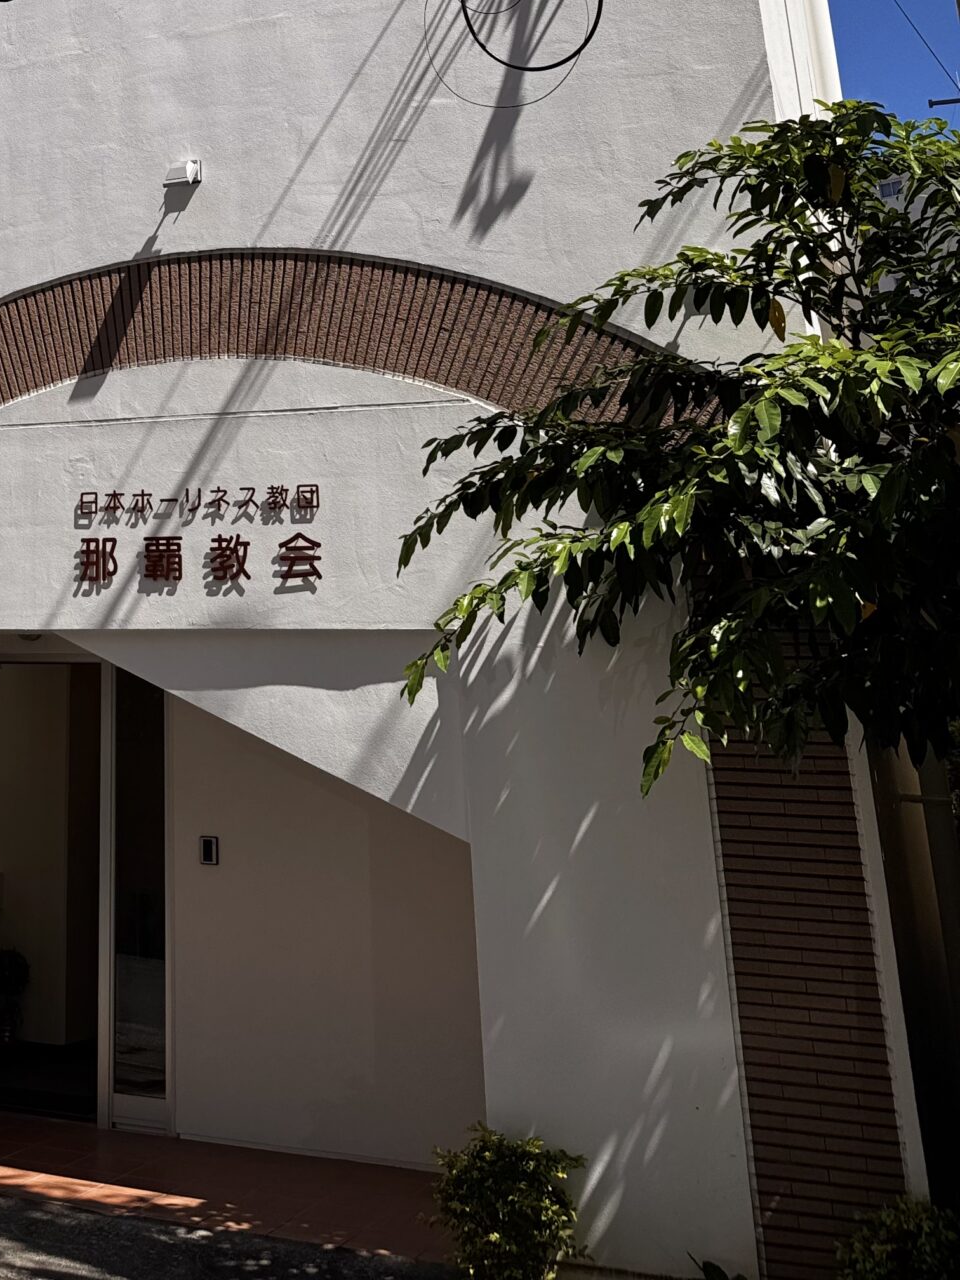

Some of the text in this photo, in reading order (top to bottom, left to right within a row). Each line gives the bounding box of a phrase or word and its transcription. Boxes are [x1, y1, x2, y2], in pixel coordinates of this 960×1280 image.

[79, 484, 320, 515] 日本ホーリネス教団
[78, 532, 323, 582] 那覇教会
